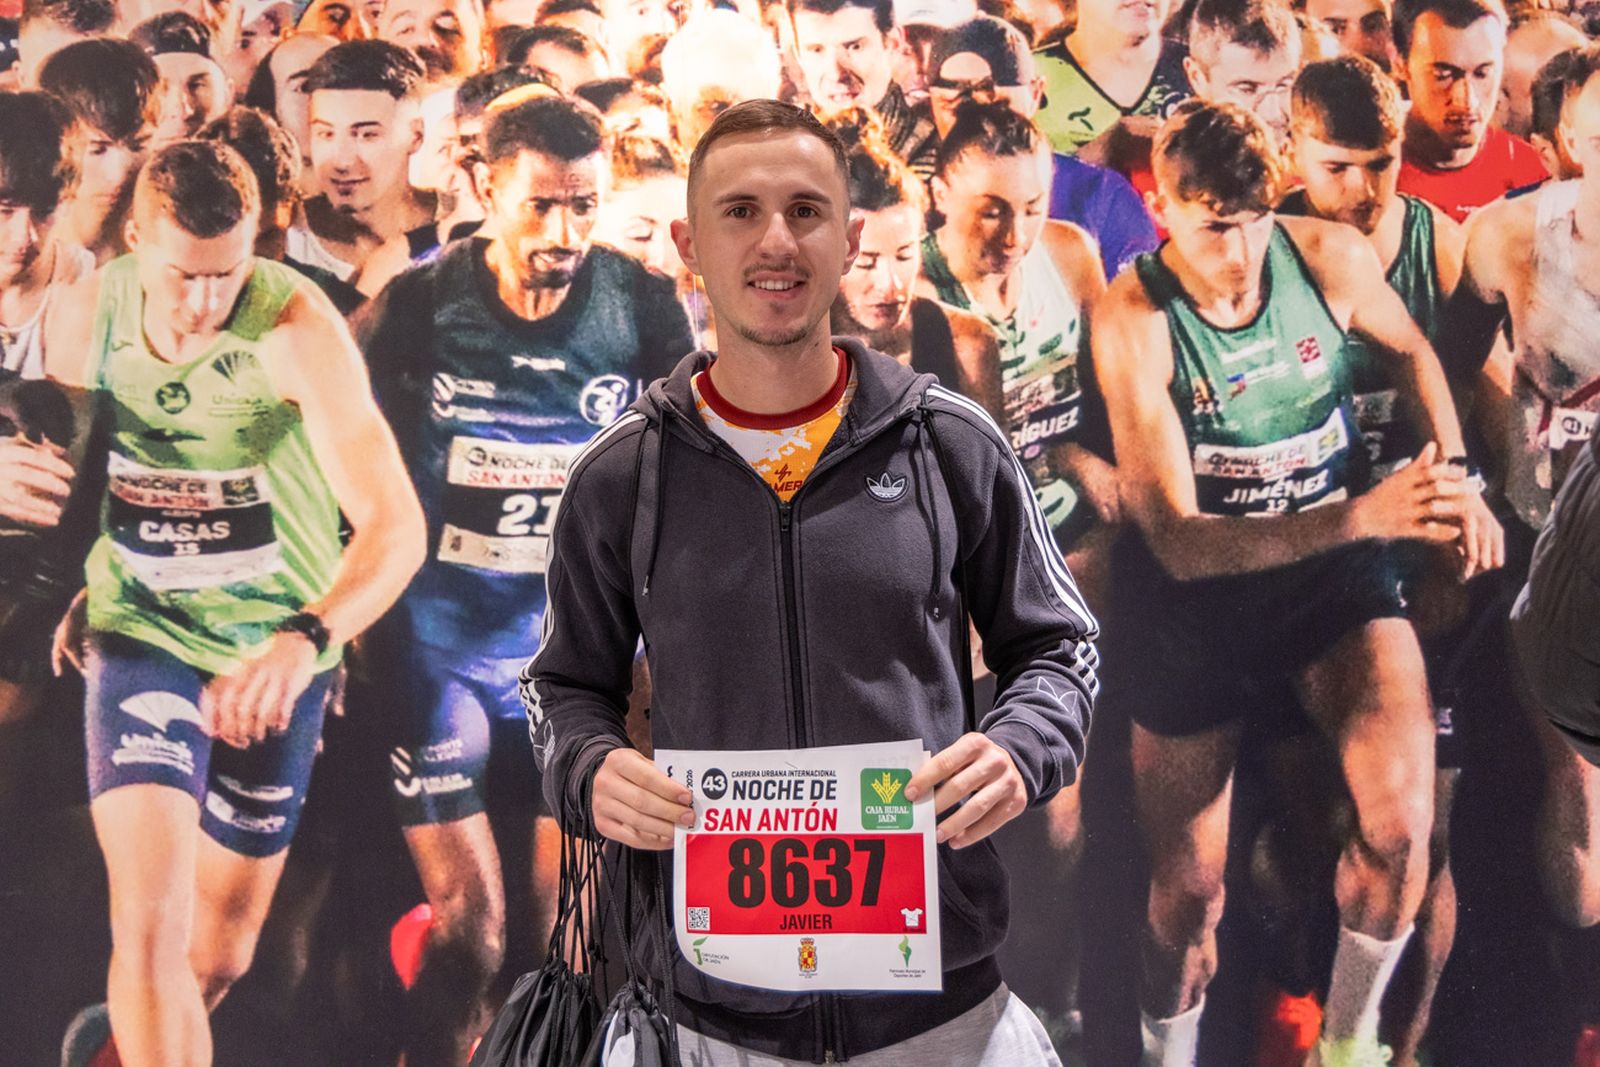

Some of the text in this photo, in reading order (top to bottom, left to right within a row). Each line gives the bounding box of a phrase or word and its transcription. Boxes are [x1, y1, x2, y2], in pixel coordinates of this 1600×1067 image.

[490, 455, 544, 470] NOCHE
[468, 470, 502, 485] SAN
[1223, 468, 1329, 503] JIMÉNEZ
[1266, 499, 1290, 512] 12
[496, 493, 562, 536] 21
[139, 520, 231, 543] CASAS
[731, 769, 837, 778] CARRERA URBANA INTERNACIONAL
[702, 775, 726, 792] 43
[732, 779, 838, 801] NOCHE DE
[704, 808, 752, 831] SAN
[757, 801, 838, 831] ANTÓN
[865, 806, 909, 814] CAJA RURAL
[878, 814, 897, 823] JAÉN
[728, 838, 885, 908] 8637
[779, 914, 833, 930] JAVIER
